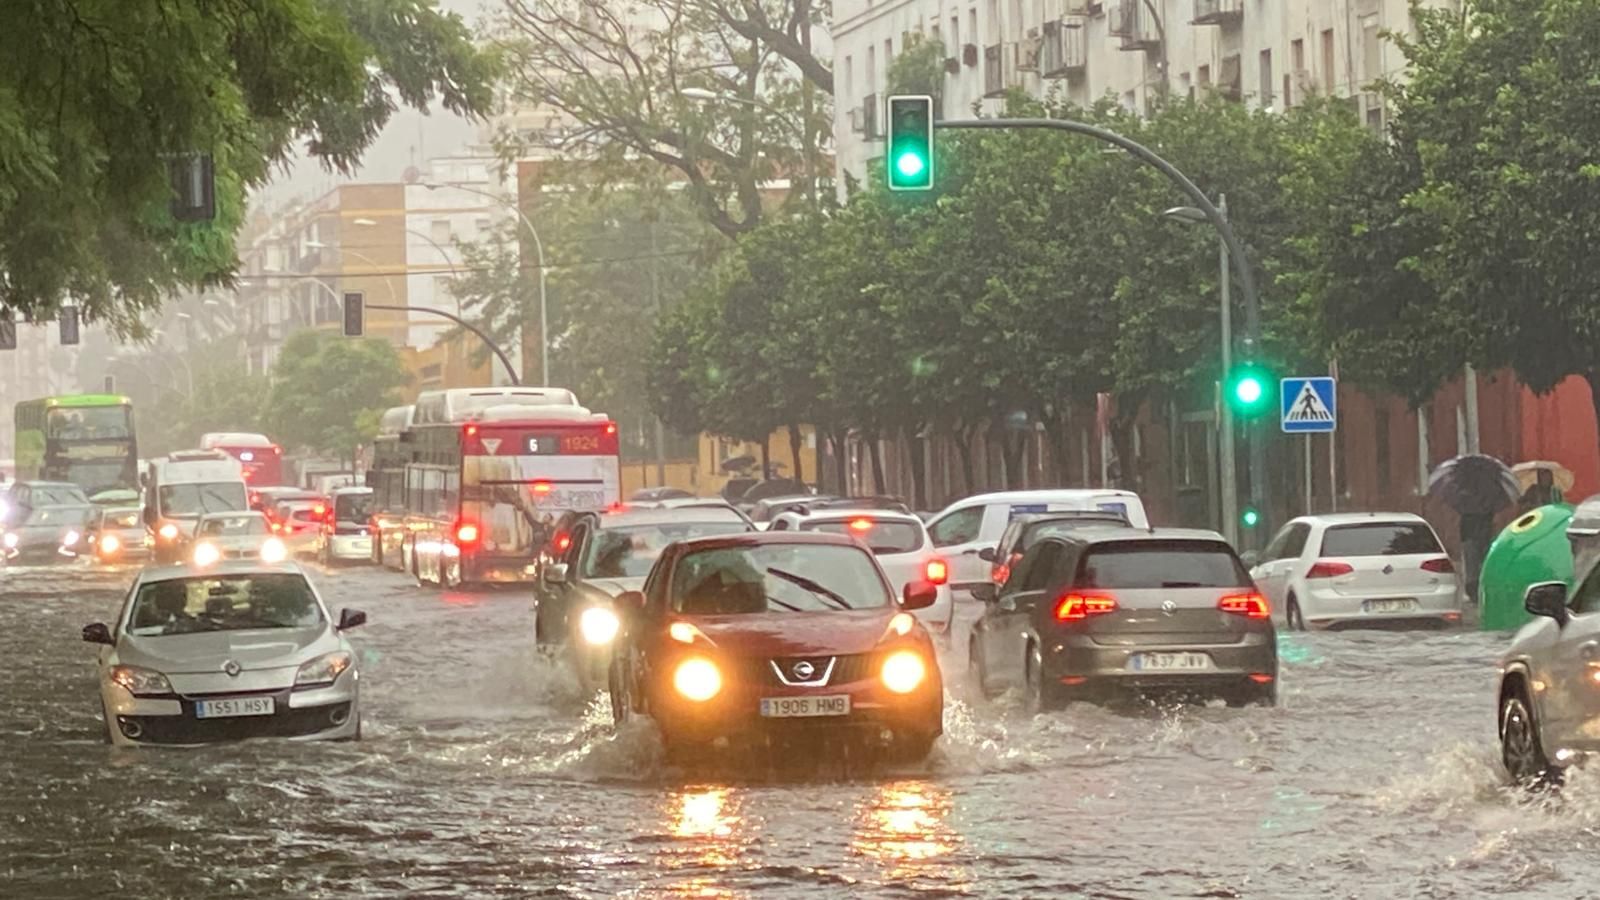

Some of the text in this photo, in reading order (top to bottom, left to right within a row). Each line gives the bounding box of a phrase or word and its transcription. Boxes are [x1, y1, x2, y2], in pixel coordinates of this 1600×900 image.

[529, 438, 538, 452] 6
[565, 437, 599, 450] 1924
[1143, 655, 1175, 668] 7637
[208, 699, 270, 715] 1551 HSY
[773, 698, 844, 714] 1906 HMB
